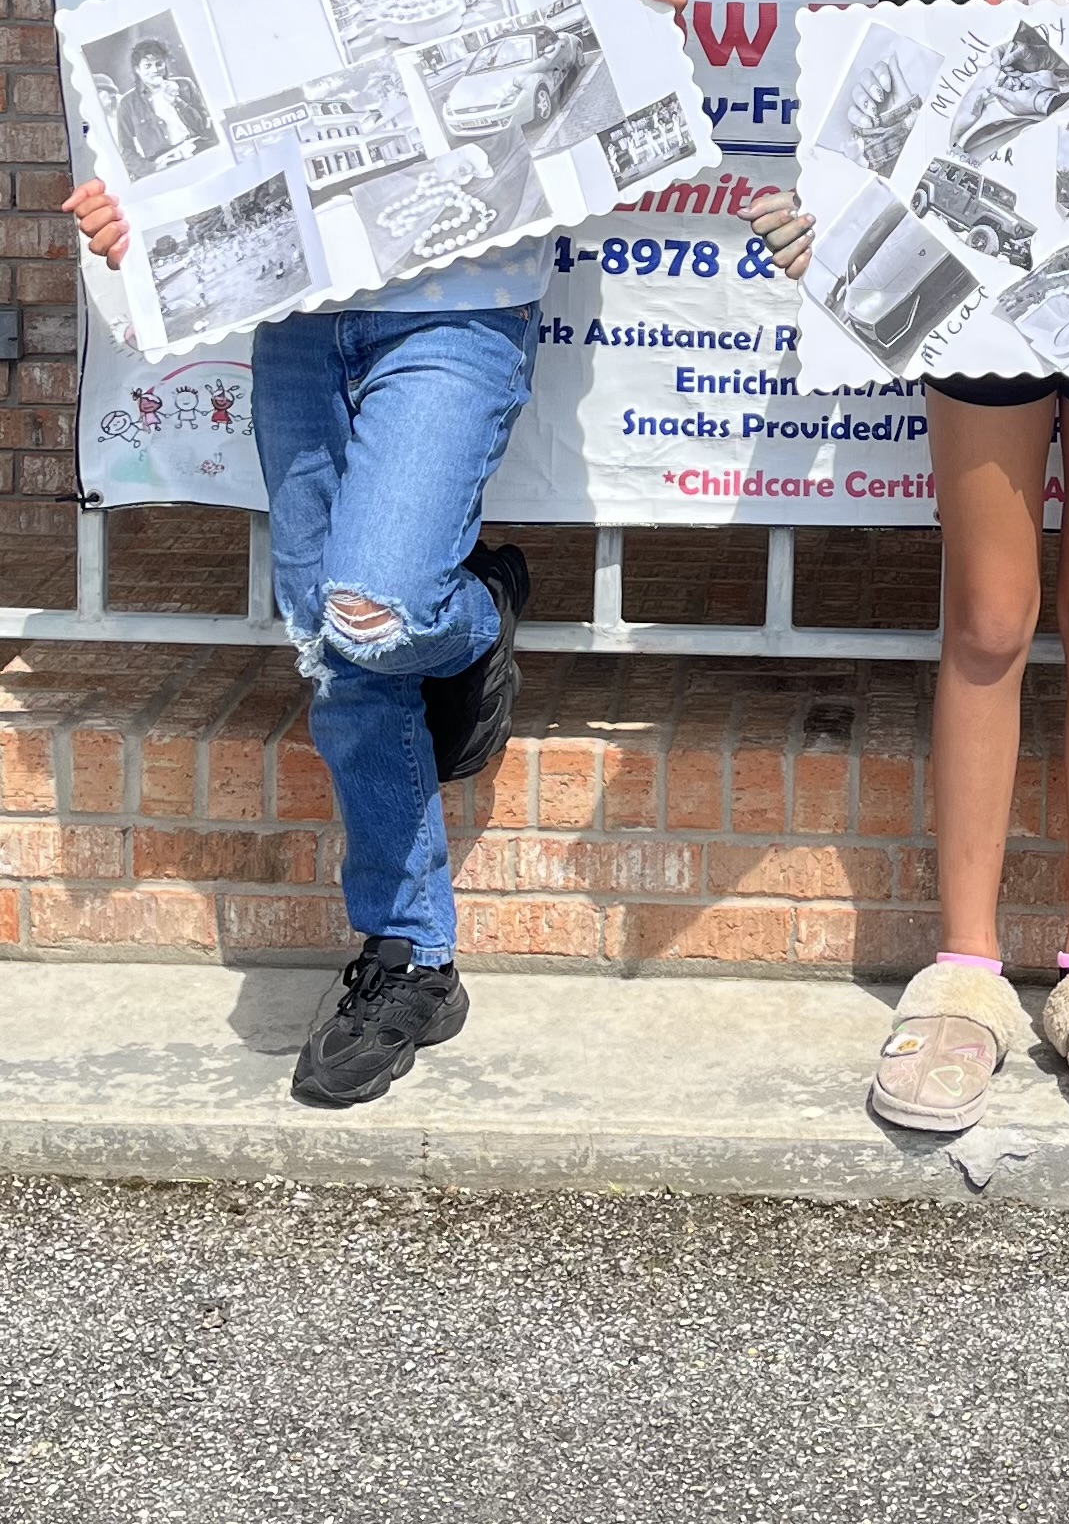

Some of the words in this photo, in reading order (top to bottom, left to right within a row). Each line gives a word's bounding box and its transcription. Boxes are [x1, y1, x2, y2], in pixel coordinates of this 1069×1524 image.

[233, 106, 308, 140] Alabama
[737, 237, 775, 279] &
[584, 319, 764, 353] Assistance/
[622, 408, 731, 439] Snacks
[742, 412, 928, 443] Provided/P
[845, 470, 936, 499] Certif
